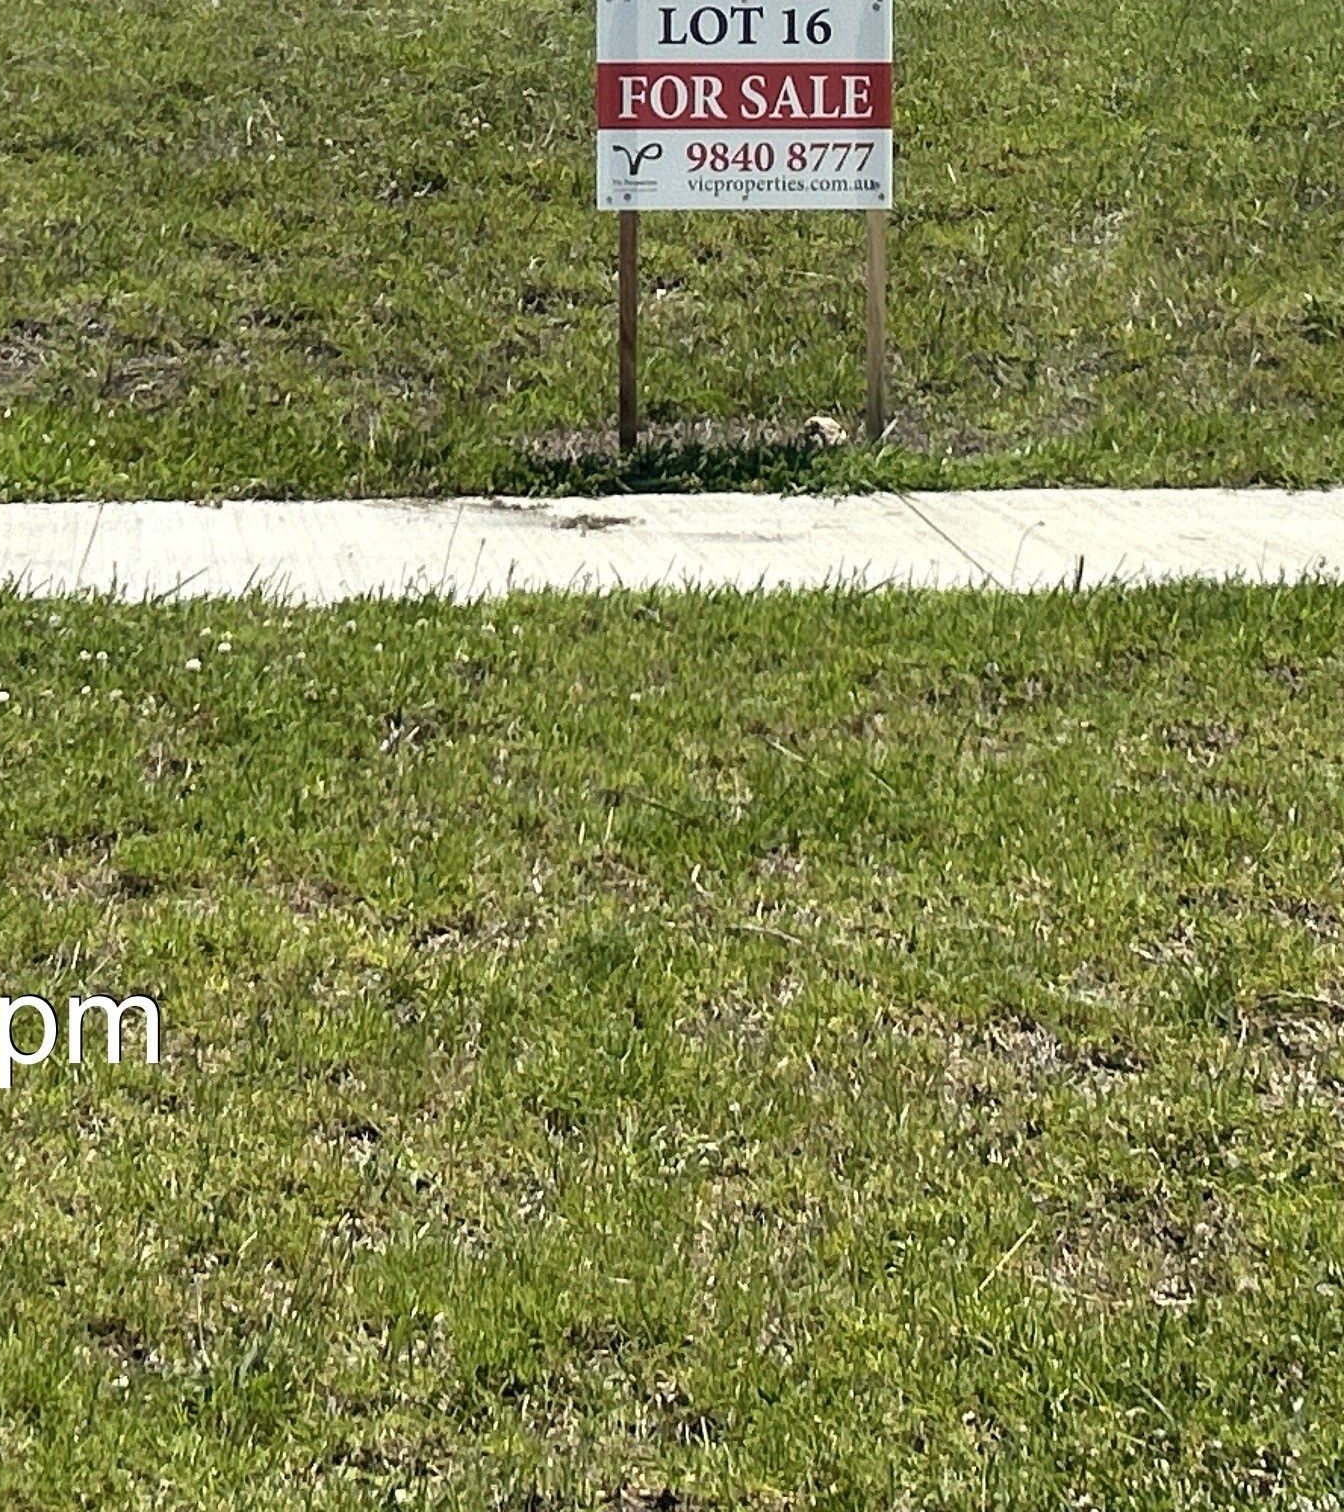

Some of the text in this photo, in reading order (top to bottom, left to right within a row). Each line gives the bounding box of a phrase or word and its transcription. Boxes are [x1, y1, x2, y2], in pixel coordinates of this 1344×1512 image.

[658, 6, 832, 45] LOT 16
[618, 75, 873, 119] FOR SALE
[686, 142, 875, 173] 9840 8777
[688, 176, 876, 197] vicproperties.com.au
